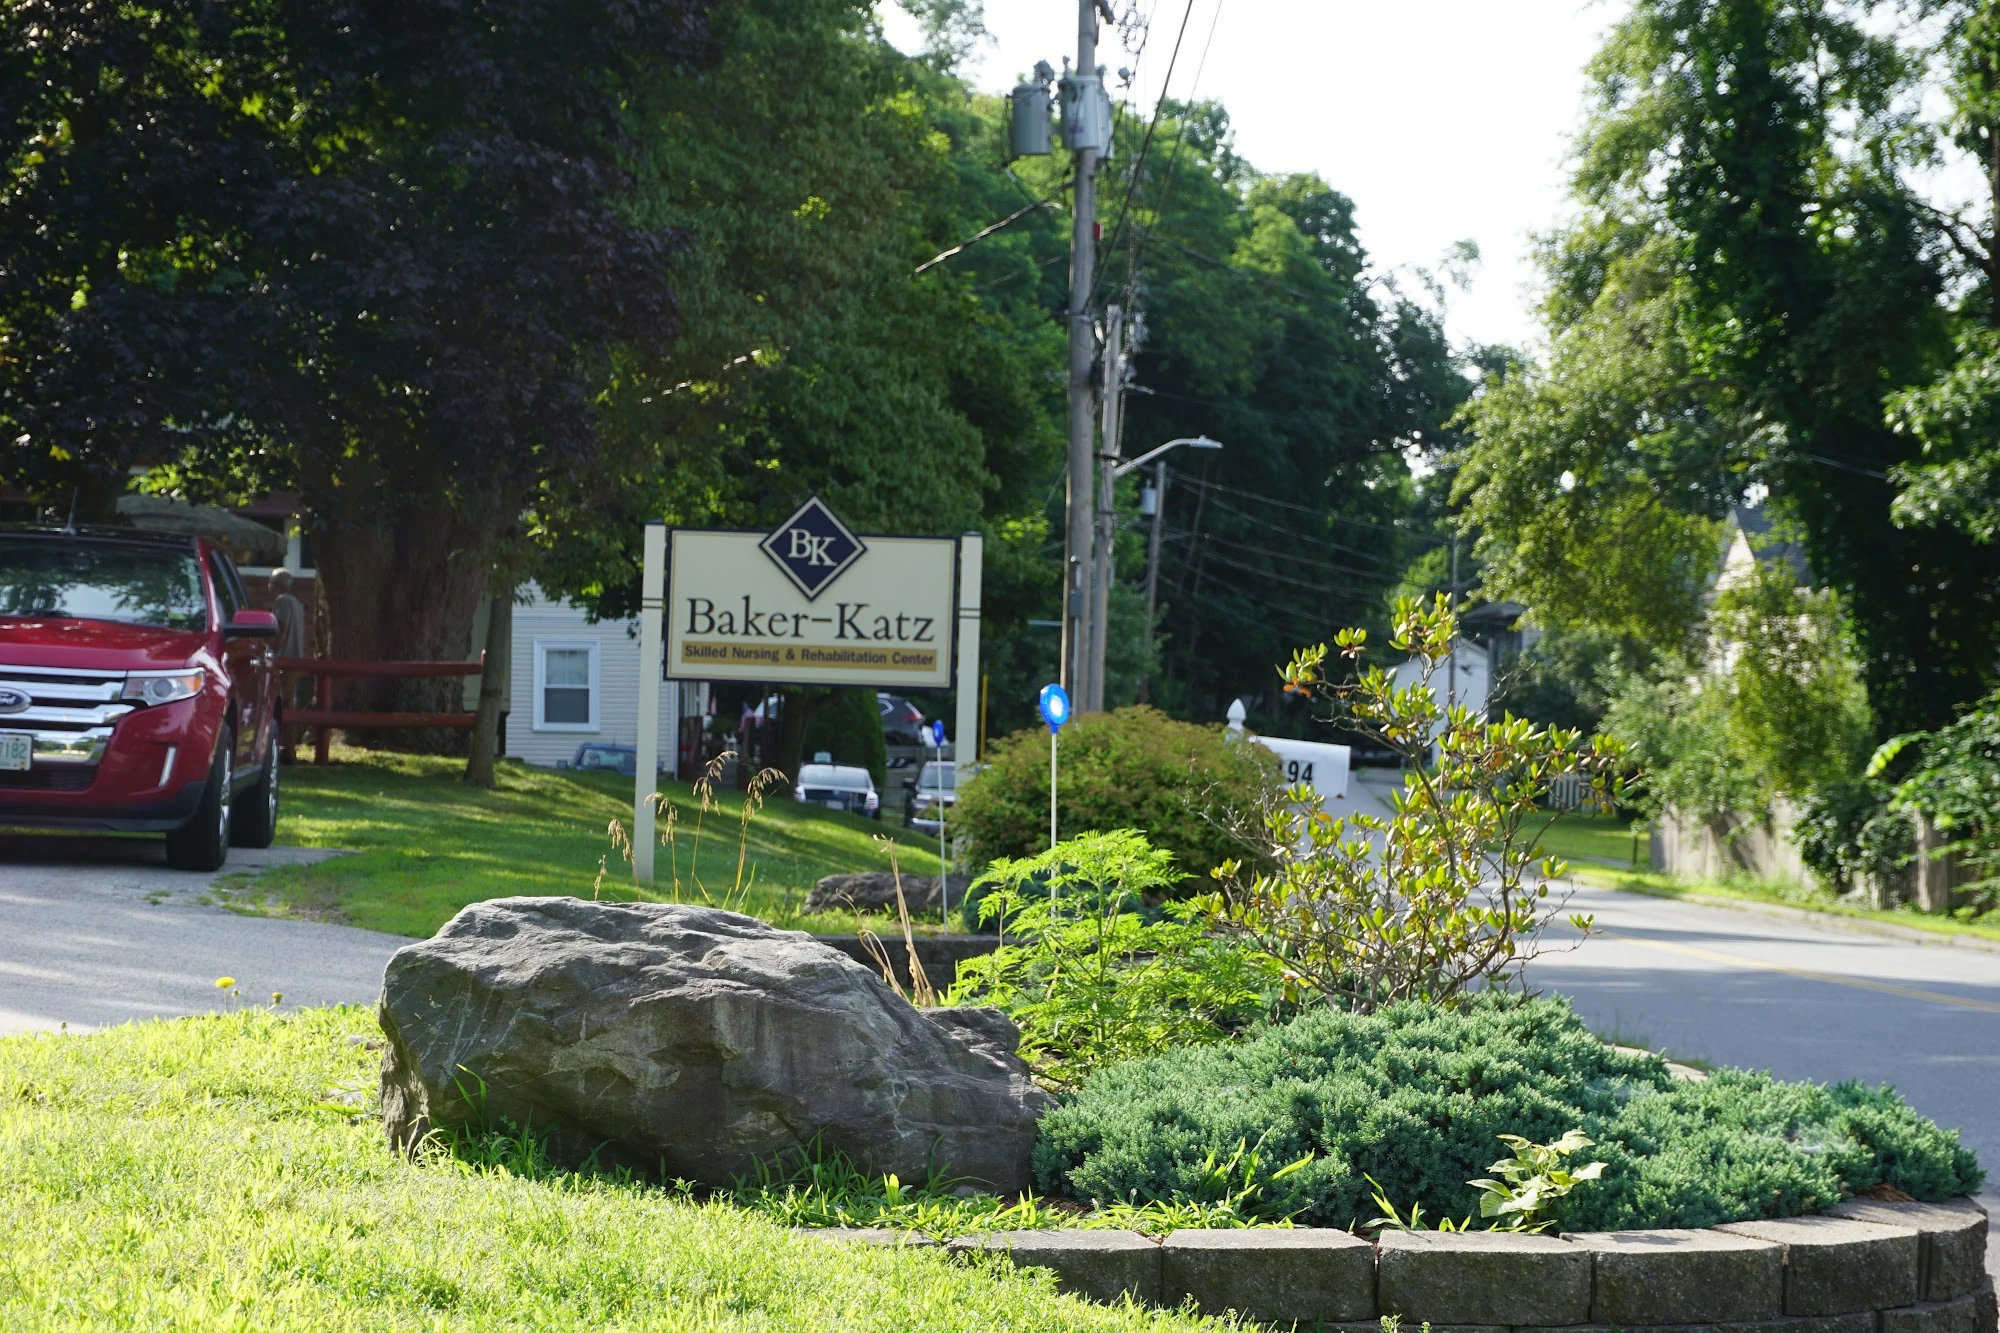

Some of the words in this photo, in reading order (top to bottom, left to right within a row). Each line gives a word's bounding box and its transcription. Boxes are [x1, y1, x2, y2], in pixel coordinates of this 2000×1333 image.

[684, 645, 727, 659] Skilled
[732, 646, 780, 662] Nursing
[785, 648, 796, 661] &
[801, 648, 887, 664] Rehabilitation
[892, 651, 935, 666] Center
[1278, 760, 1313, 785] 94
